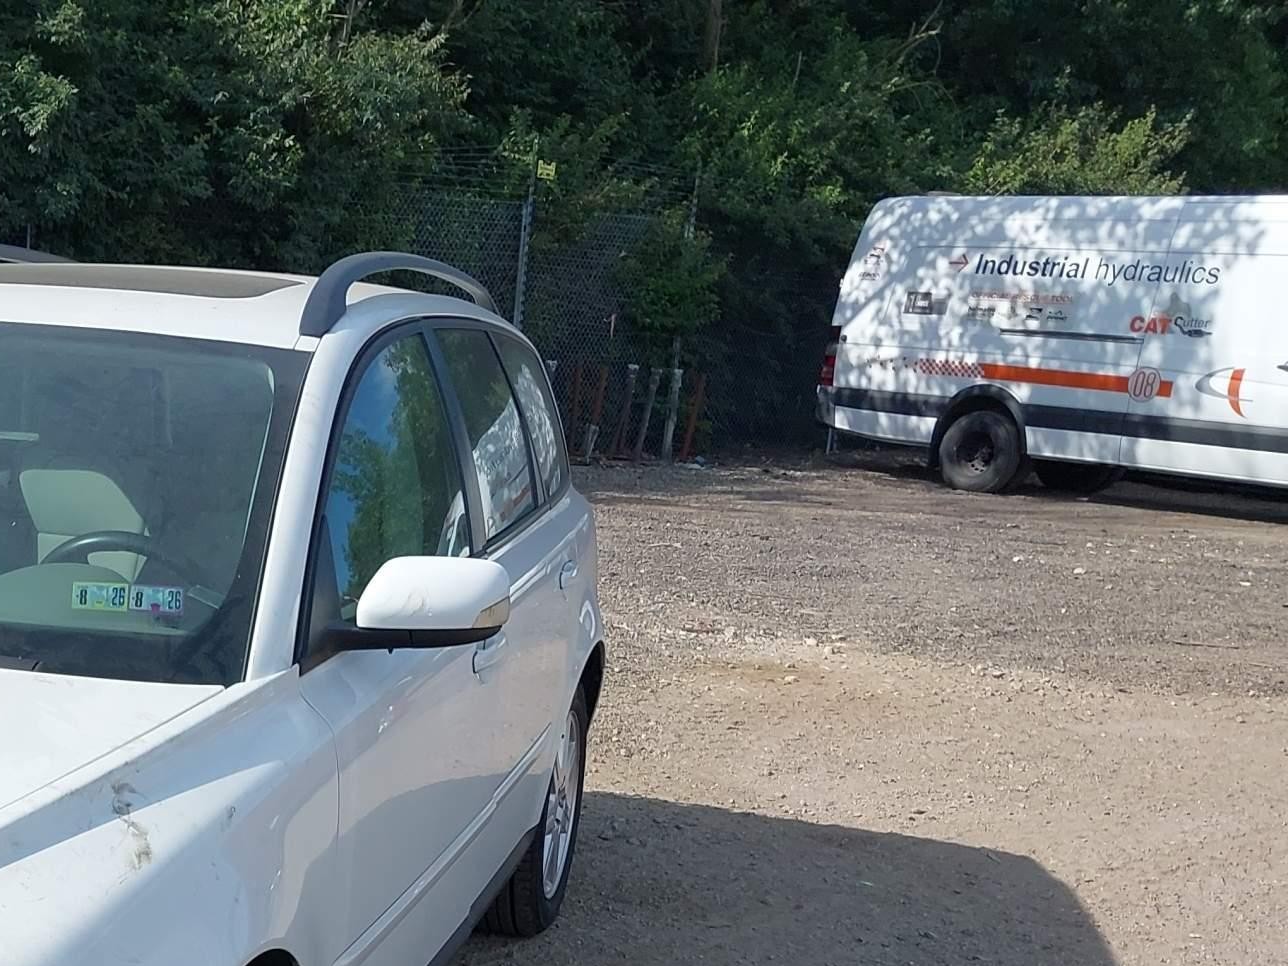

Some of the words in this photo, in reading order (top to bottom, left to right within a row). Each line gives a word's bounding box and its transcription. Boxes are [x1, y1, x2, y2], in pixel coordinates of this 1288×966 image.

[974, 253, 1090, 279] Industrial
[1094, 256, 1221, 287] hydraulics
[1129, 315, 1173, 335] CAT
[1174, 316, 1211, 332] Cutter
[1133, 370, 1157, 399] 08
[79, 589, 88, 606] 8
[112, 587, 126, 606] 26
[134, 591, 144, 608] 8
[167, 590, 182, 610] 26
